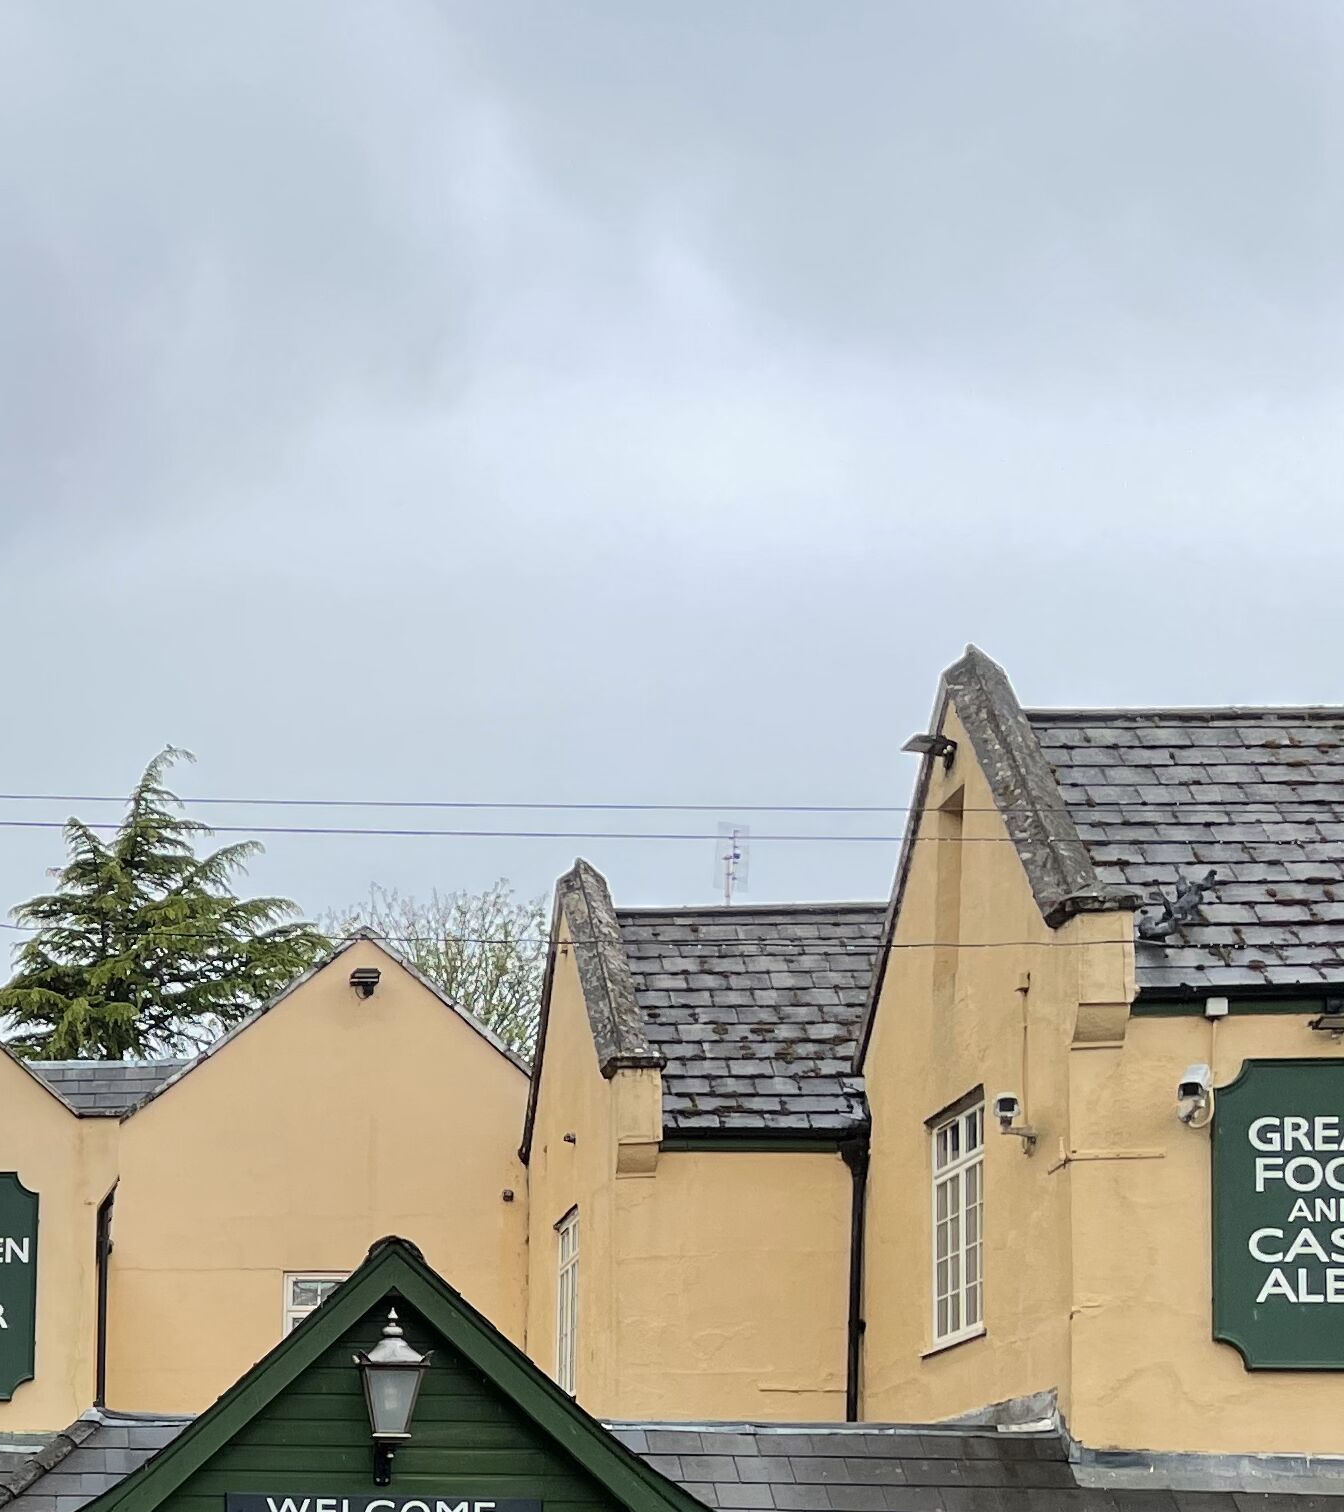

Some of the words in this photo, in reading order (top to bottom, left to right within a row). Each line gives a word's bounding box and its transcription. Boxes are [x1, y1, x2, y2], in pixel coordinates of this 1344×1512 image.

[1248, 1116, 1344, 1152] GRE
[1287, 1197, 1344, 1222] AN
[1255, 1267, 1344, 1303] ALE
